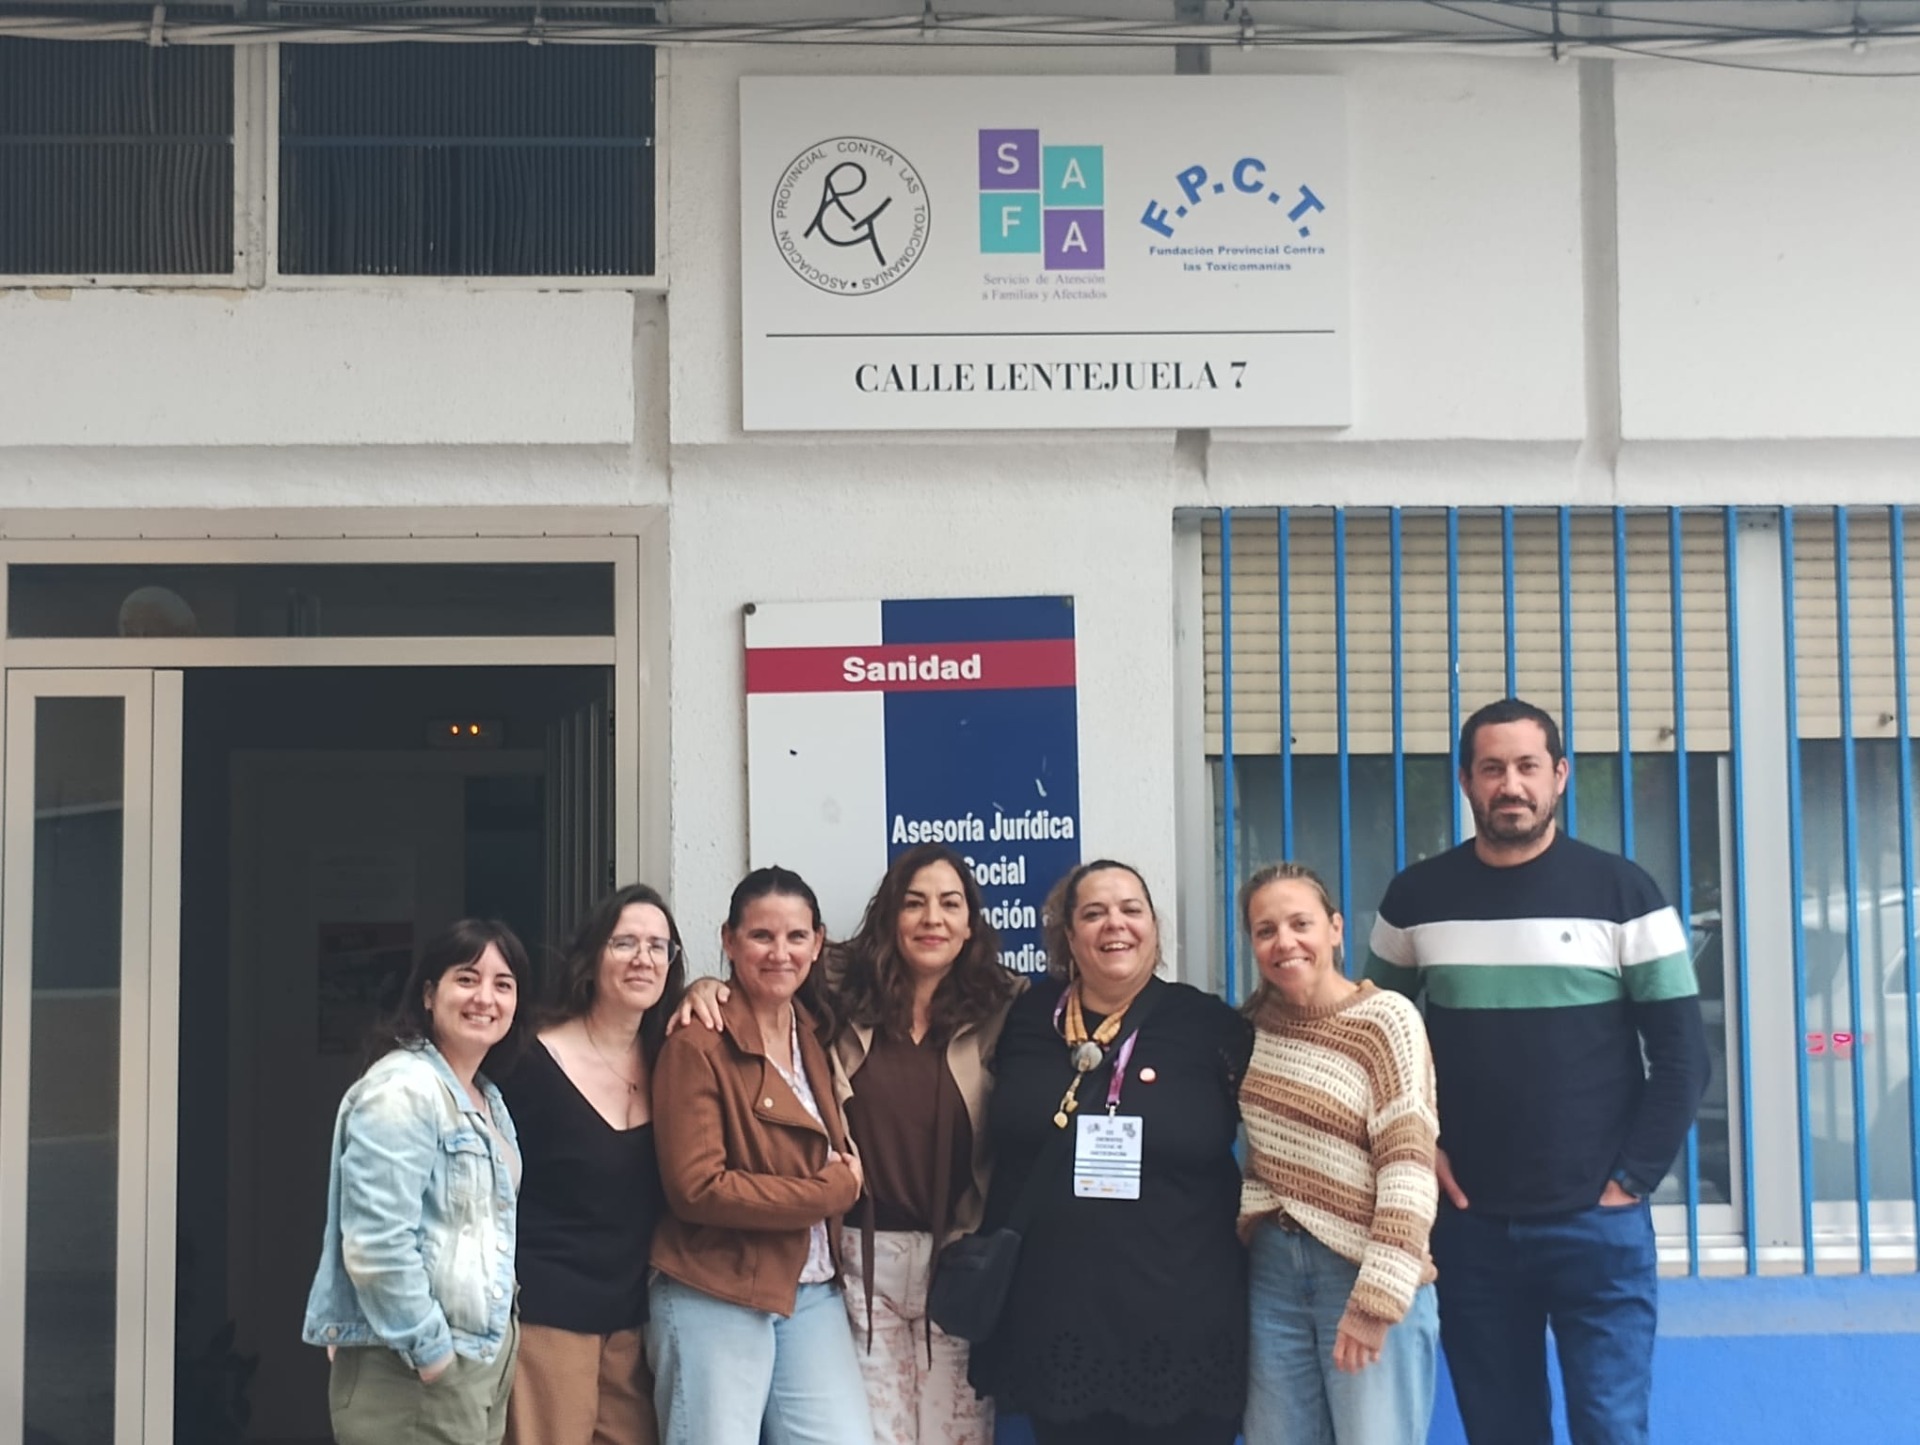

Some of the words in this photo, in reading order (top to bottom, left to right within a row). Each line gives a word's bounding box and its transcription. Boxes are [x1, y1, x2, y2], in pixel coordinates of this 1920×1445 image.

[776, 148, 828, 219] PROVINCIAL
[836, 141, 895, 166] CONTRA
[899, 168, 920, 194] LAS
[1140, 157, 1326, 239] F.P.C.T.
[1149, 246, 1214, 256] Fundación
[1218, 245, 1280, 256] Provincial
[1283, 245, 1325, 255] Contra
[983, 273, 1030, 285] Servicio
[1035, 274, 1049, 285] de
[1055, 273, 1106, 285] Atención
[1183, 262, 1201, 271] las
[992, 289, 1039, 300] Familias
[1041, 292, 1049, 302] y
[1053, 288, 1108, 300] Afectados
[854, 363, 975, 392] CALLE
[985, 361, 1219, 391] LENTEJUELA
[1230, 361, 1248, 389] 7
[843, 654, 981, 682] Sanidad
[892, 812, 985, 844] Asesoría
[989, 809, 1075, 841] Jurídica
